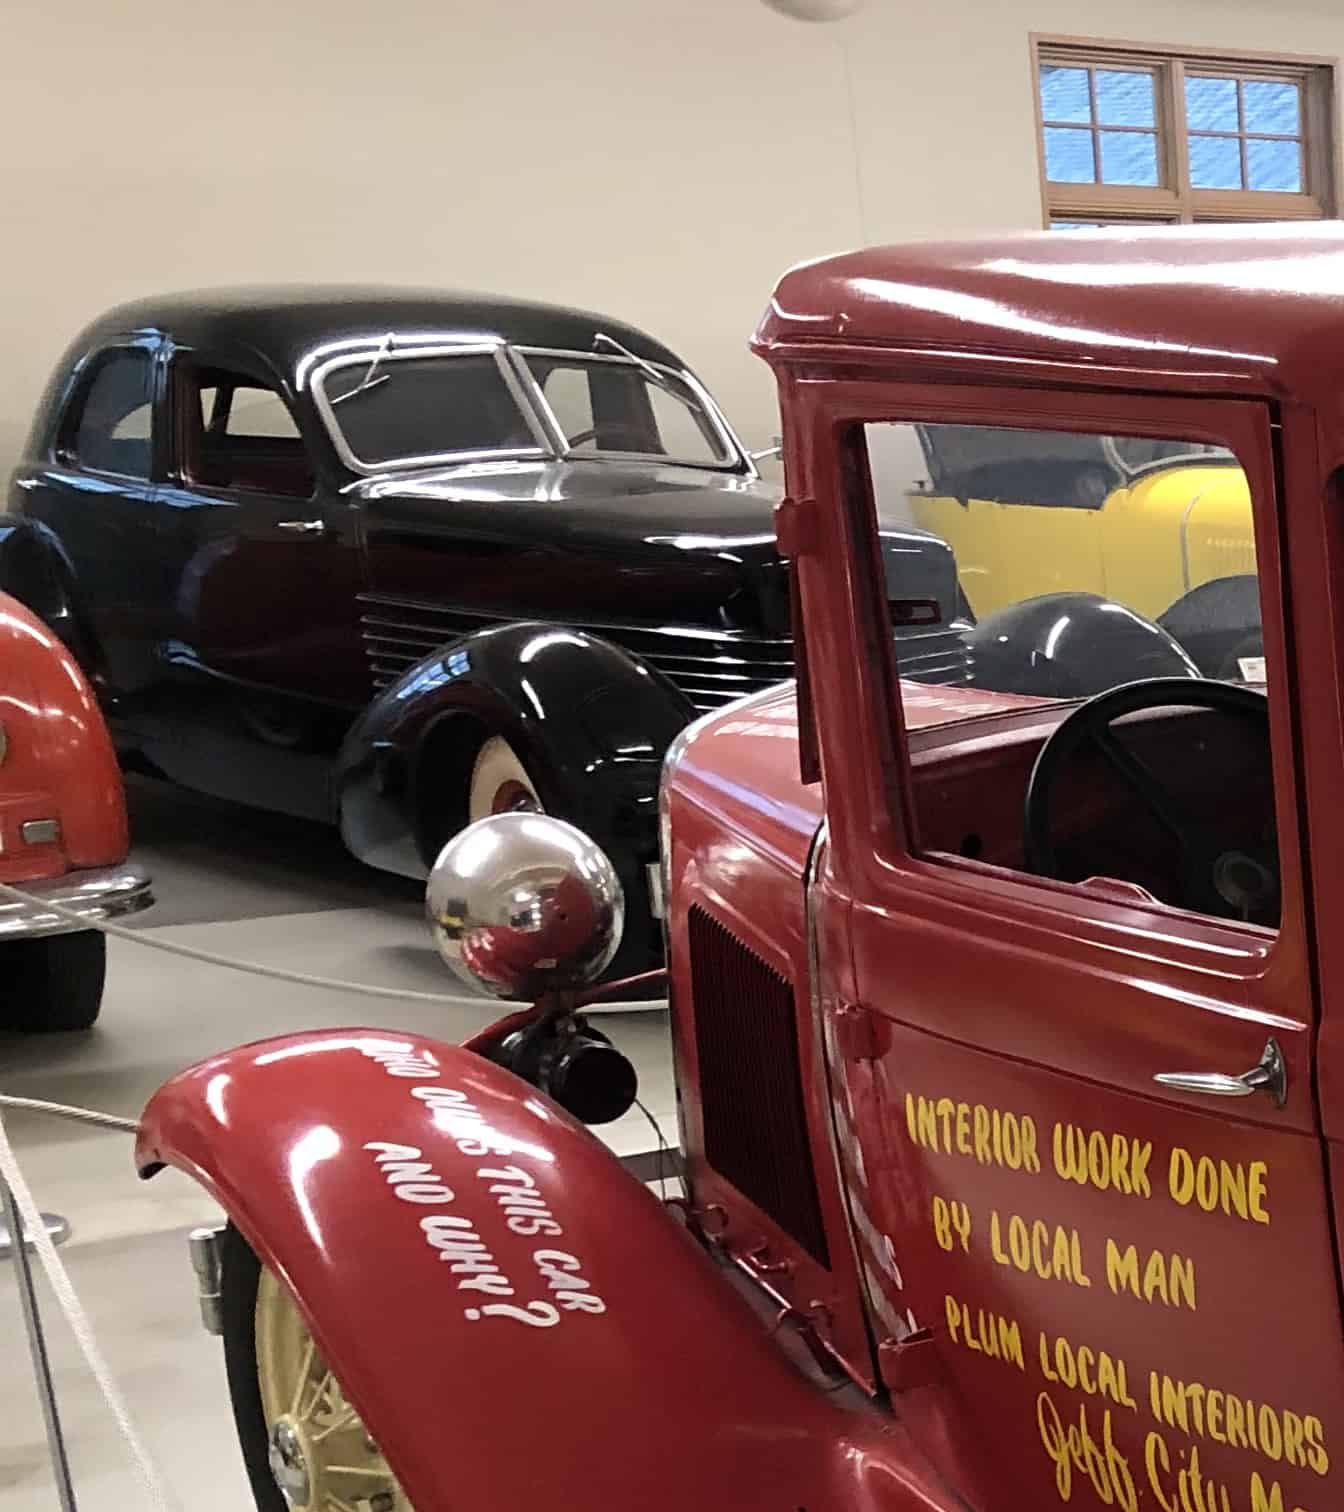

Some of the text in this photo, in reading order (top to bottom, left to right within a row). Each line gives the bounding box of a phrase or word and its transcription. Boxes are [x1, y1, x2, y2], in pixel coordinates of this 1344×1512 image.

[906, 1093, 1270, 1225] INTERIOR WORK DONE
[363, 1142, 560, 1327] AND WHY?
[477, 1166, 563, 1236] THIS
[532, 1250, 606, 1314] CAR
[933, 1197, 1196, 1311] BY LOCAL MAN
[946, 1295, 1329, 1476] PLUM LOCAL INTERIORS
